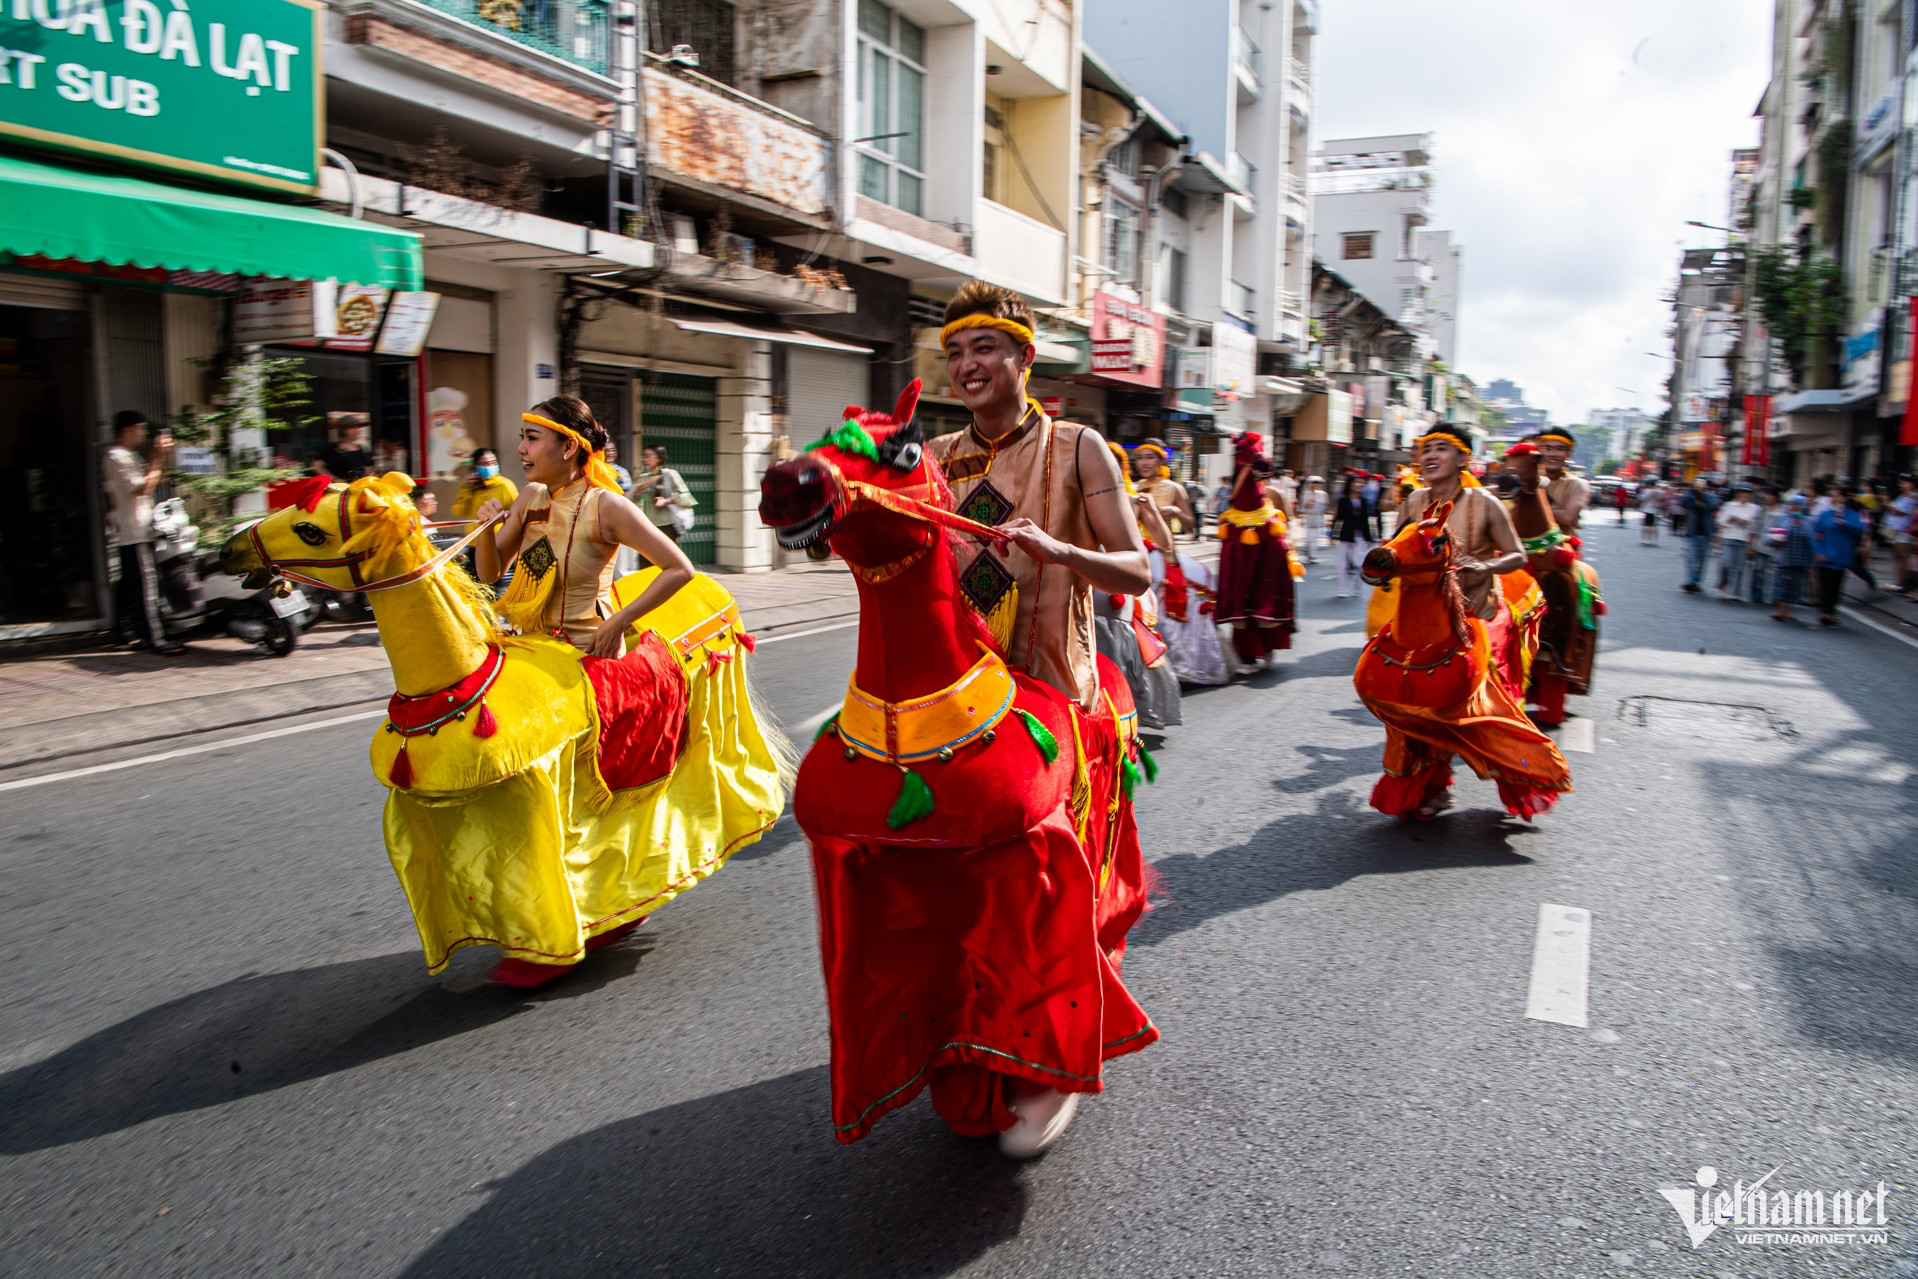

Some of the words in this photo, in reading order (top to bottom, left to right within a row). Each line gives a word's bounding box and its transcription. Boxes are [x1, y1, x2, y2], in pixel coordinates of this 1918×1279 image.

[119, 0, 201, 67] ĐÀ
[209, 22, 299, 96] LẠT
[56, 62, 160, 117] SUB
